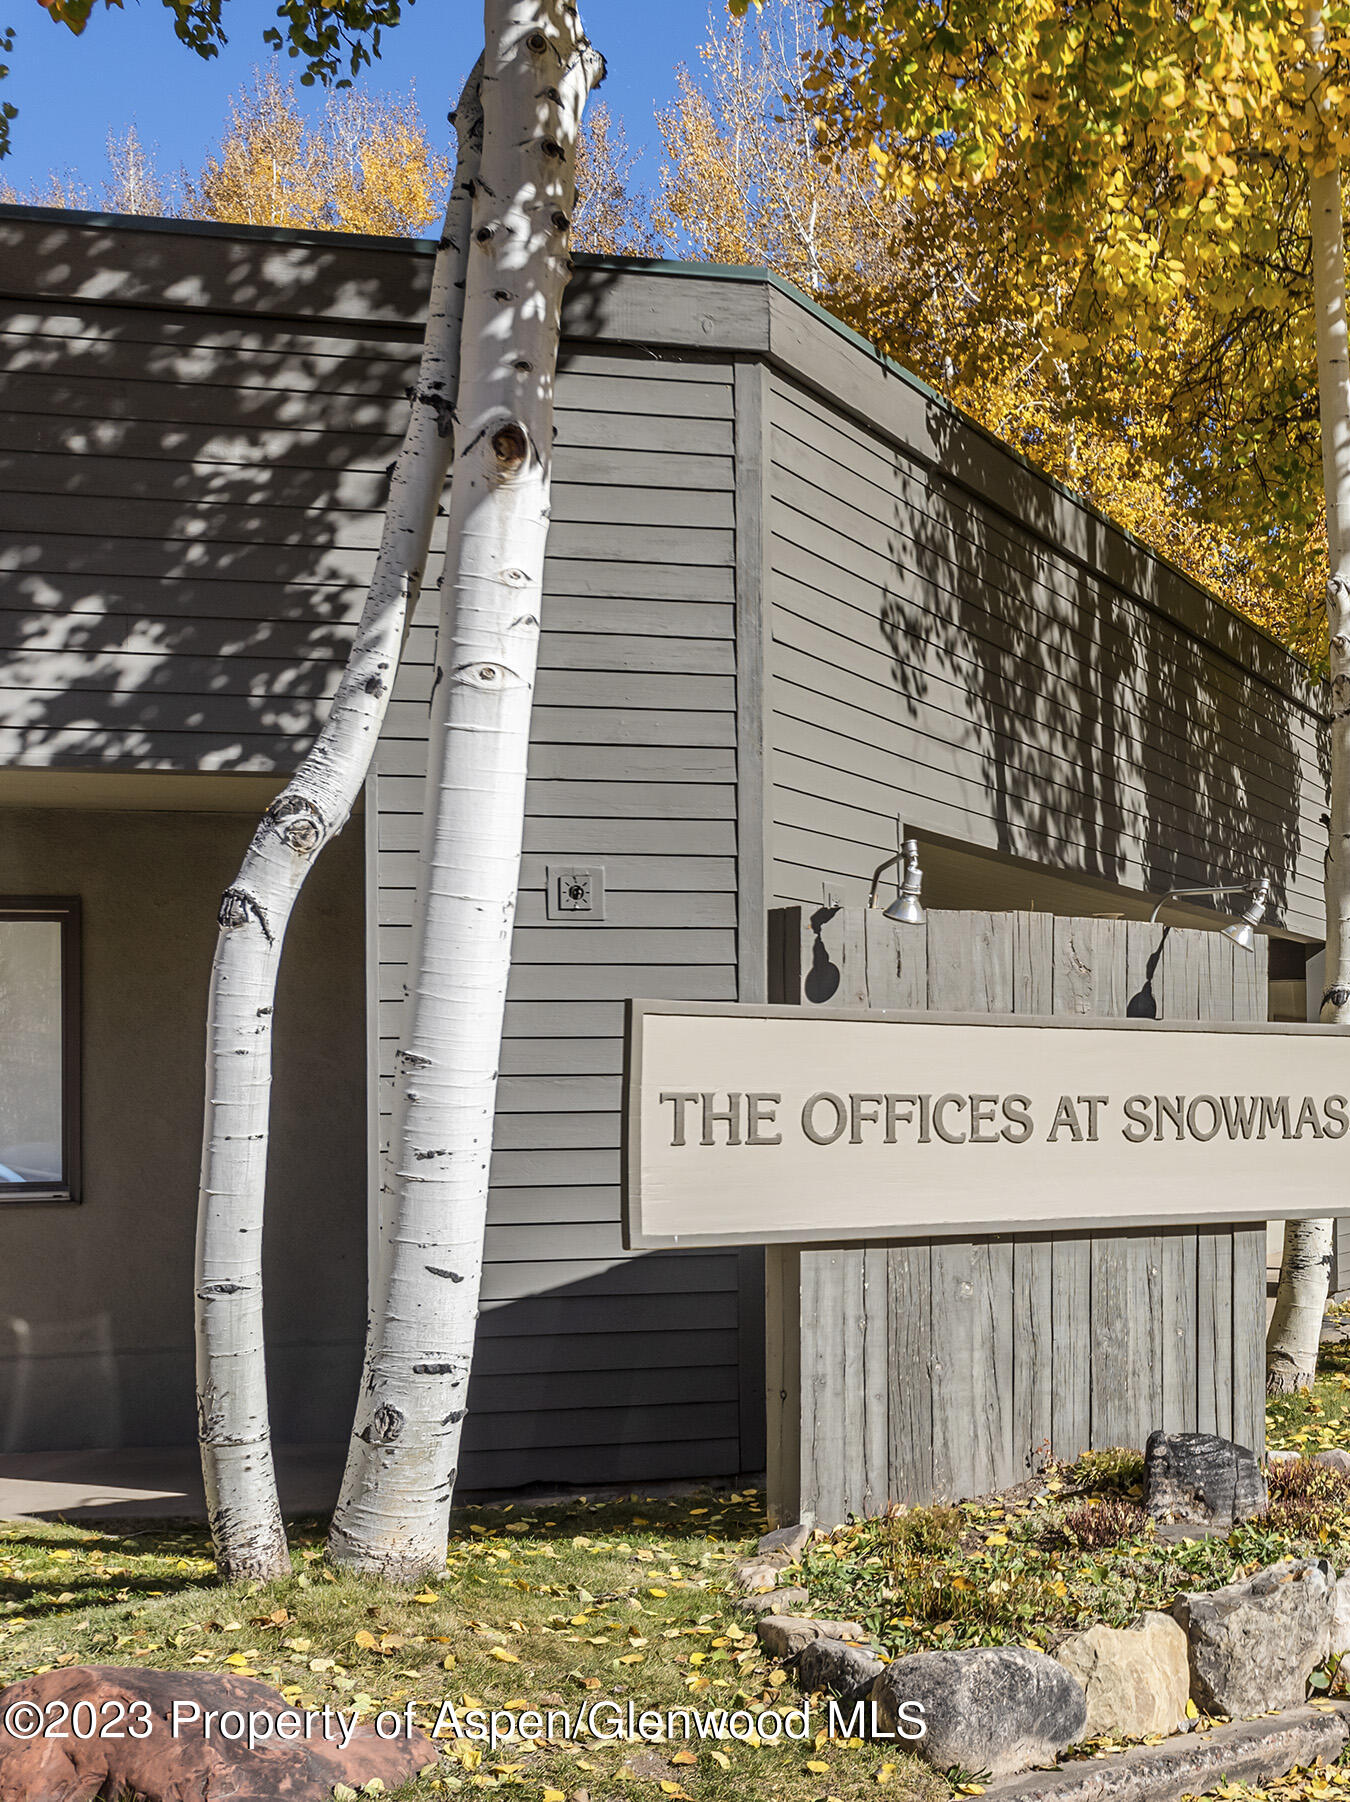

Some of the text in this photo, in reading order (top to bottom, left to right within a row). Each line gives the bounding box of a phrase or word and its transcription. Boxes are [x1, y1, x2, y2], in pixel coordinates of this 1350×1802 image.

[659, 1092, 783, 1146] THE
[801, 1091, 1033, 1146] OFFICES
[1046, 1095, 1109, 1143] AT
